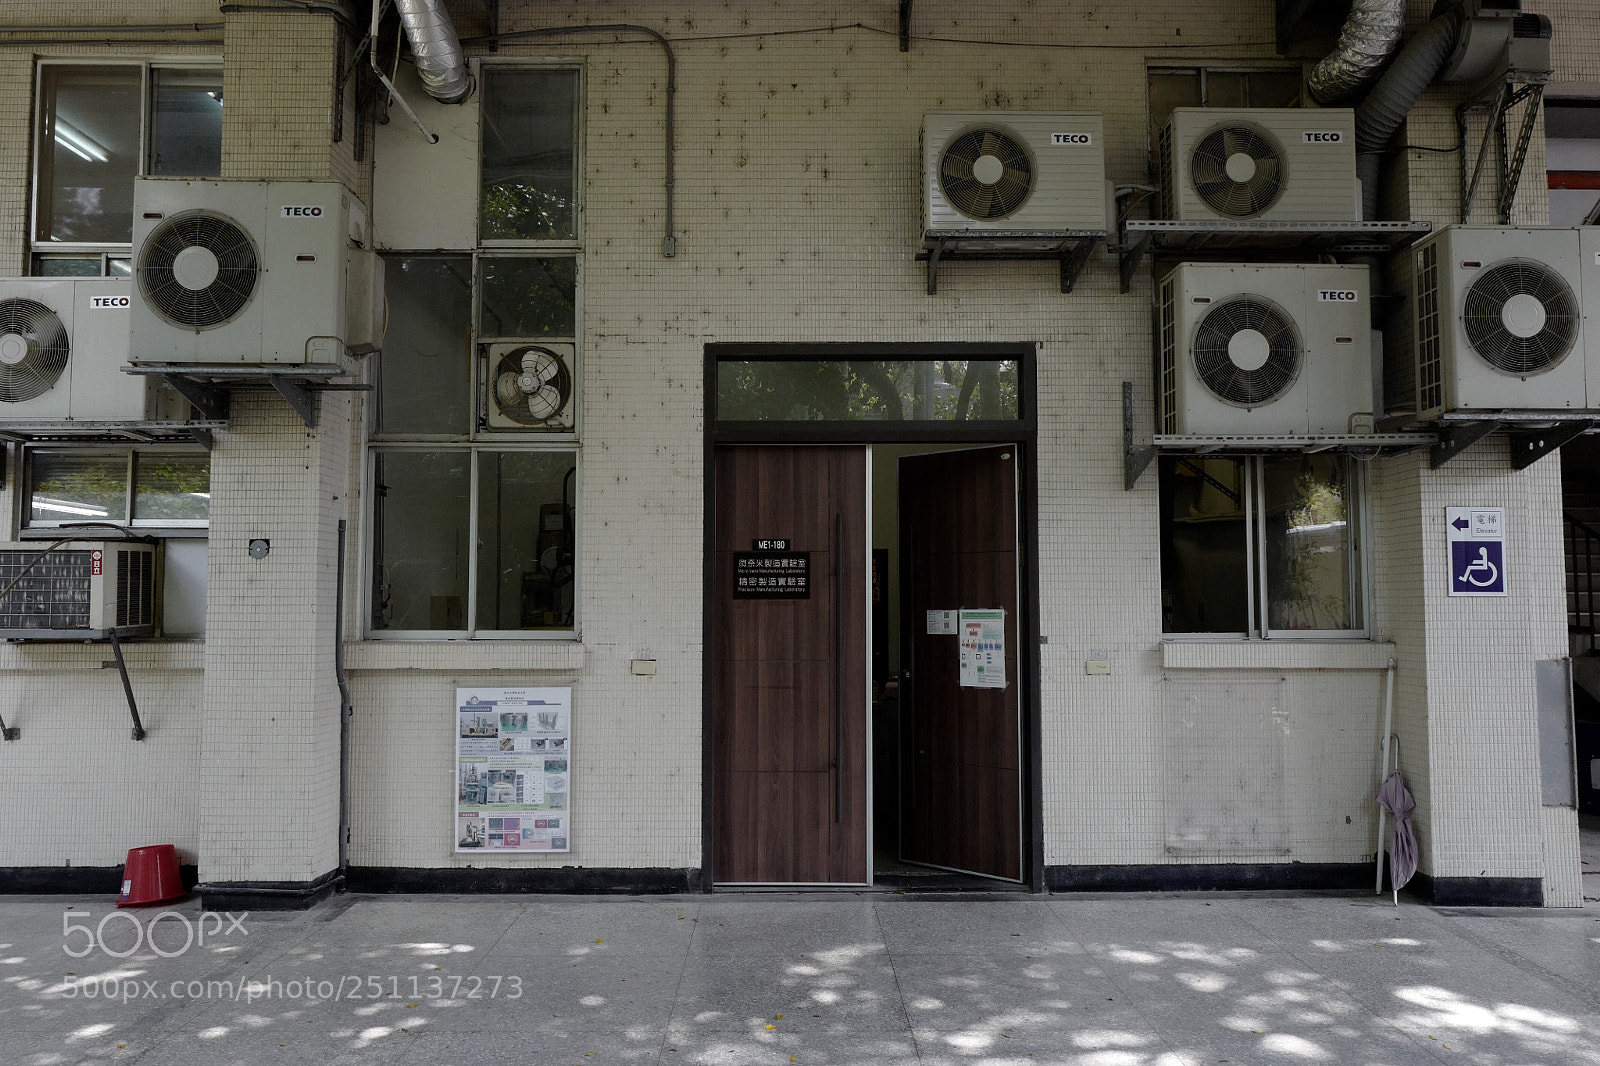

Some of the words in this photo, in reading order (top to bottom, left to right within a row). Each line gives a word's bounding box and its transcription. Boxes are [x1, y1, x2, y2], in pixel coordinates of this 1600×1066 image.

[1054, 134, 1089, 144] TECO
[1305, 133, 1341, 142] TECO
[284, 207, 322, 217] TECO
[1320, 291, 1356, 301] TECO
[93, 297, 129, 307] TECO
[1477, 514, 1497, 525] 電梯
[758, 540, 785, 550] ME1-180
[738, 577, 807, 586] 精密製造實驗室
